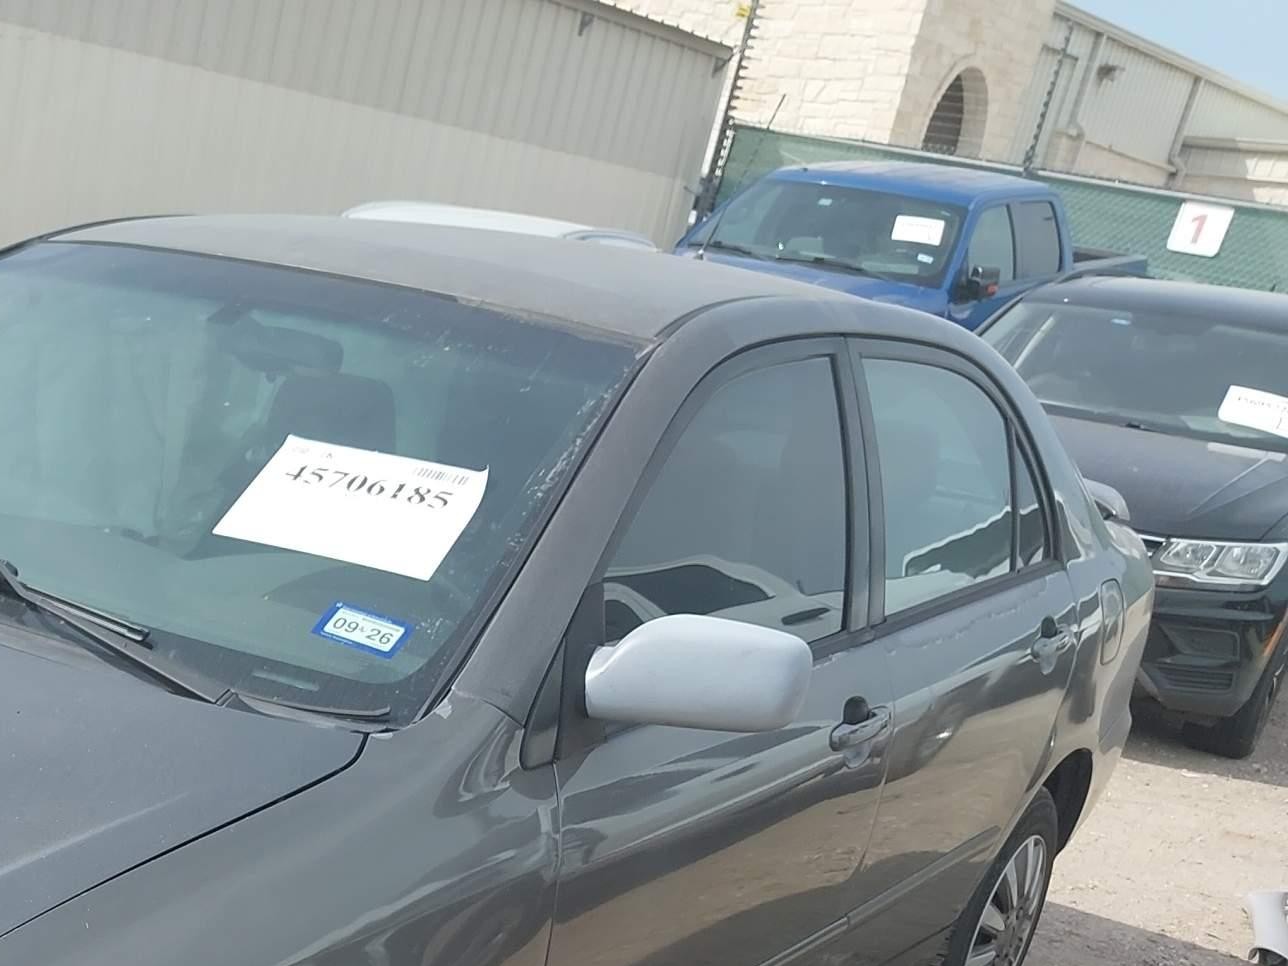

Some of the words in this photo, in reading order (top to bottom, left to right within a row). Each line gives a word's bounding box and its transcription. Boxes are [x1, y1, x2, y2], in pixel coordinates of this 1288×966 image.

[1190, 213, 1209, 245] 1
[285, 463, 455, 510] 45706185
[332, 616, 360, 633] 09
[365, 627, 394, 645] 26
